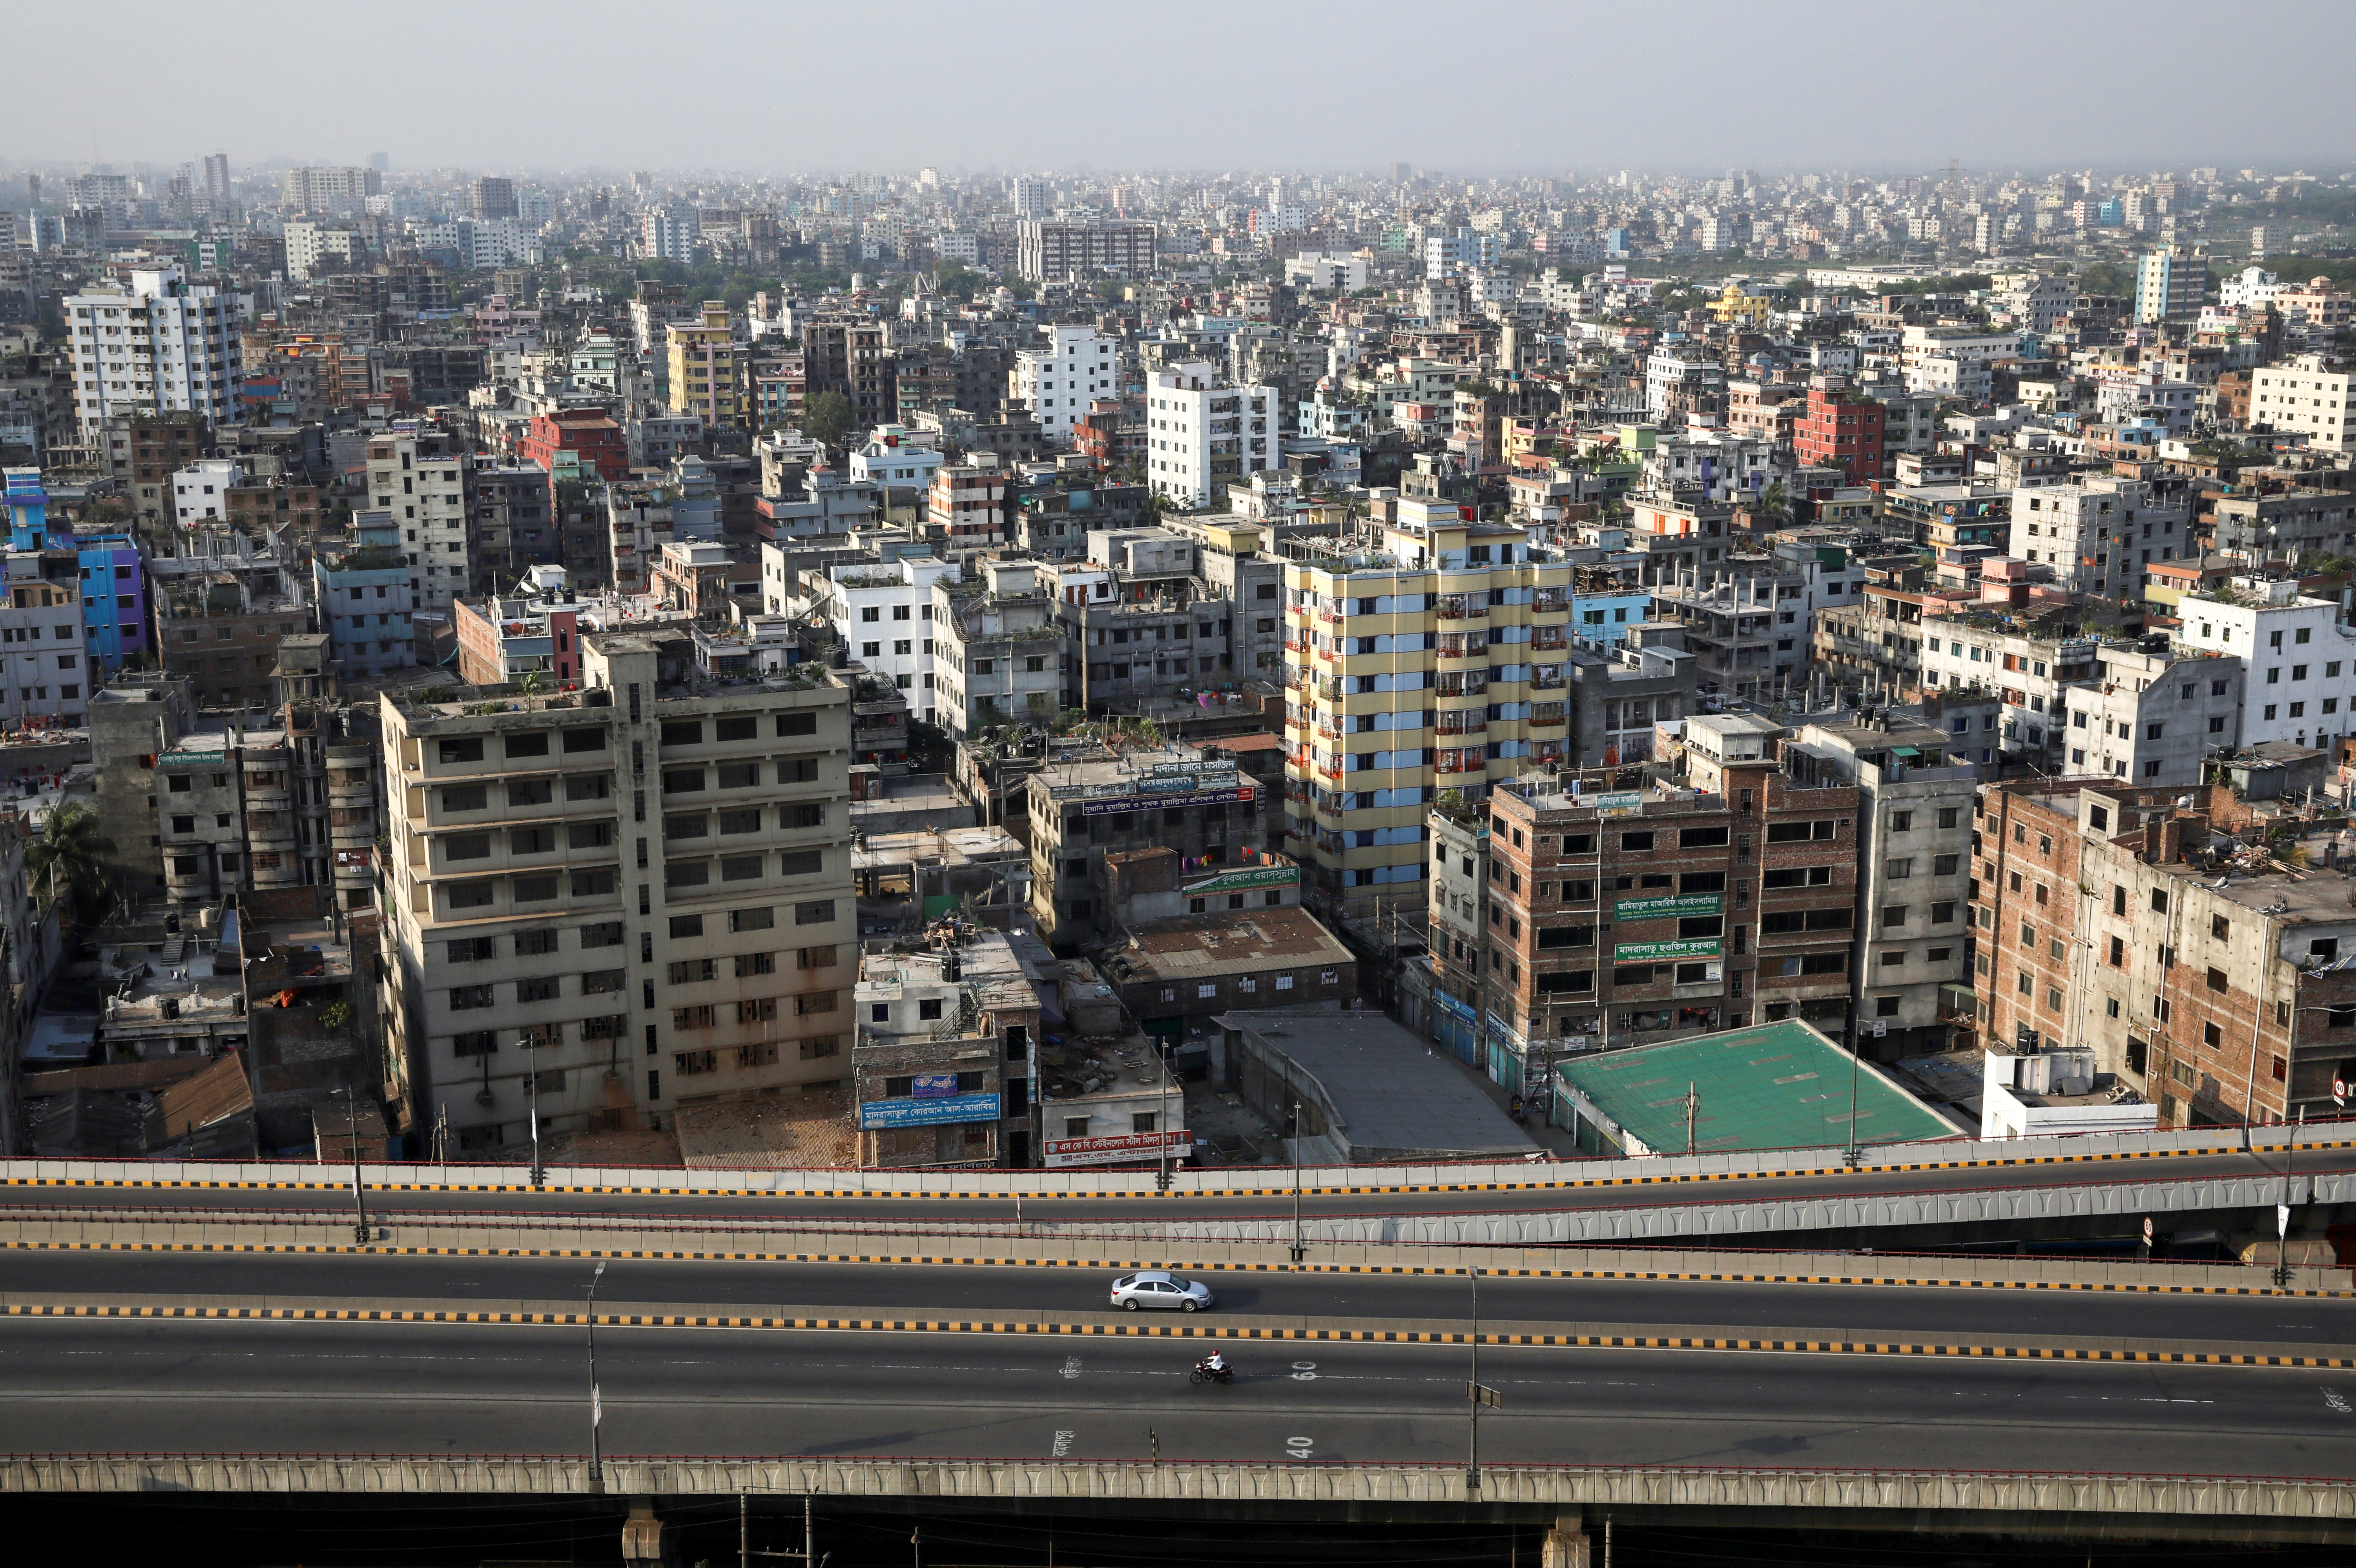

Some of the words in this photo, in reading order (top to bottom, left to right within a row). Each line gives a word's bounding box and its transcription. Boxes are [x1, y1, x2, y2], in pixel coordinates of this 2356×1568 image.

[1154, 763, 1178, 773] মদীনা
[1180, 762, 1201, 772] জামে
[1204, 760, 1235, 769] মসজিদ
[1085, 805, 1103, 814] নুরানি
[1106, 802, 1131, 812] মুয়াল্লিম
[1142, 800, 1158, 809] পৃথক
[1161, 797, 1187, 807] মুয়াল্লিমা
[1189, 795, 1214, 803] প্রশিক্ষণ
[1597, 796, 1620, 805] জামিয়াতুল
[1621, 793, 1640, 803] মাআরিফ
[1222, 873, 1251, 885] কুরআন
[1618, 901, 1648, 911] জামিয়াতুল
[1650, 898, 1676, 908] মাআরিফ
[1678, 895, 1718, 905] আলইসলামিয়া
[1619, 945, 1657, 954] মাদরাসাতু
[1659, 942, 1687, 953] ছওতিল
[1689, 941, 1717, 952] কুরআন
[2336, 1084, 2343, 1093] 40
[865, 1109, 908, 1120] মাদরাসাতুল
[911, 1107, 943, 1116] কোরআন
[945, 1101, 997, 1113] আল-আরাবিয়া
[1083, 1139, 1090, 1149] বি
[1092, 1137, 1124, 1149] স্টেইনলেস
[1126, 1135, 1141, 1146] স্টীল
[2145, 1221, 2152, 1232] 60
[1292, 1361, 1317, 1380] 60
[1052, 1430, 1076, 1457] কমলাপুর
[1286, 1437, 1313, 1459] 40
